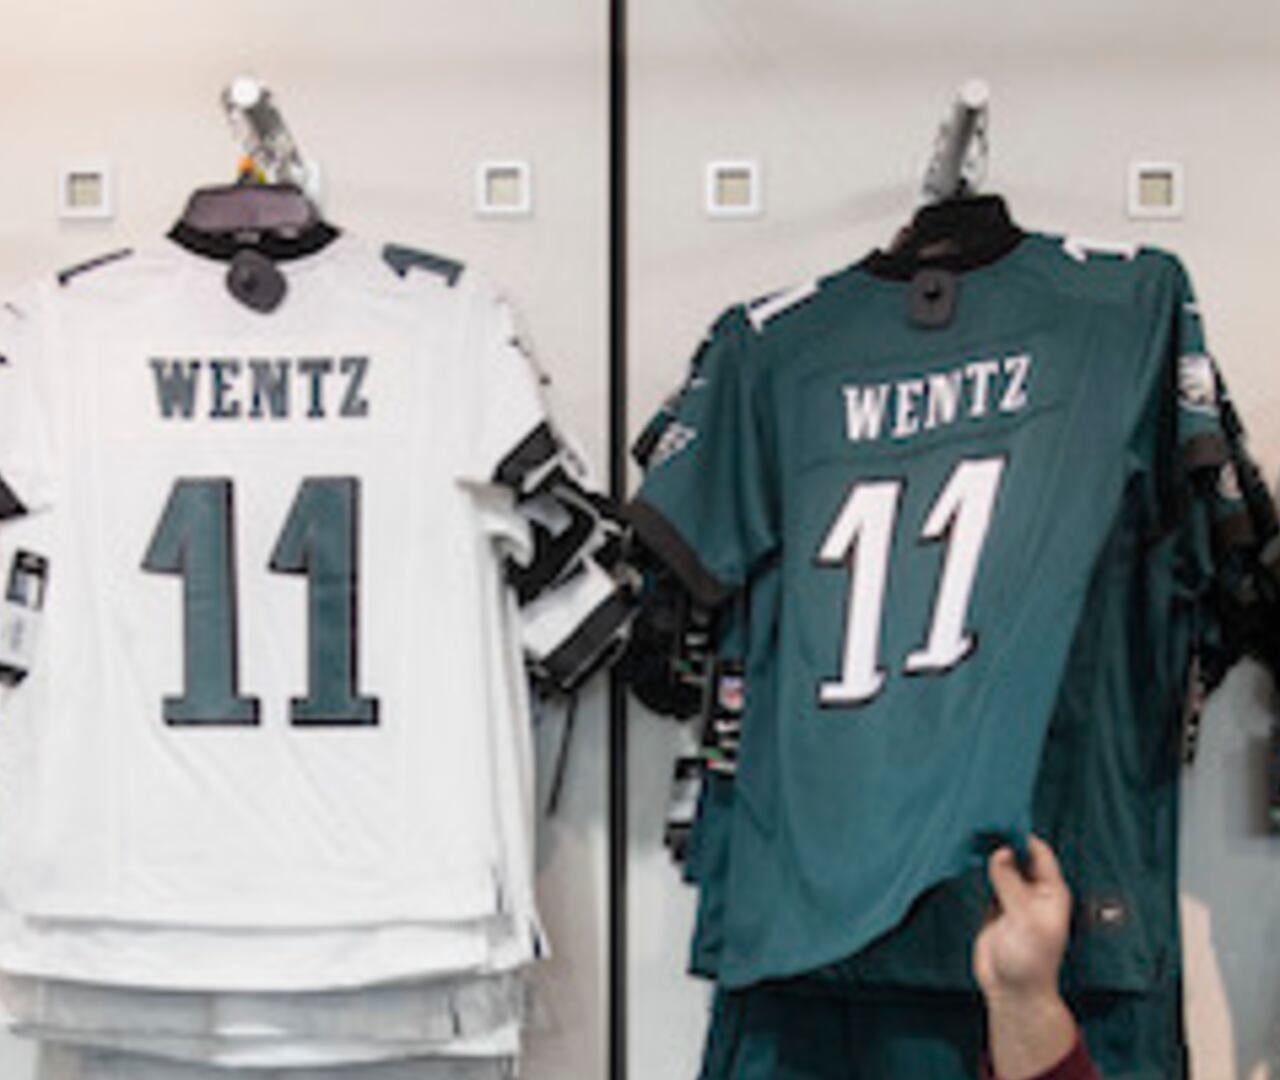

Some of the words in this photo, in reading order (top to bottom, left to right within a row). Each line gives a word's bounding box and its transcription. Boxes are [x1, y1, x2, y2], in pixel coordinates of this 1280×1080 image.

[148, 355, 371, 421] WENTZ
[843, 354, 1032, 442] WENTZ
[140, 475, 381, 730] 11
[818, 455, 1010, 709] 11
